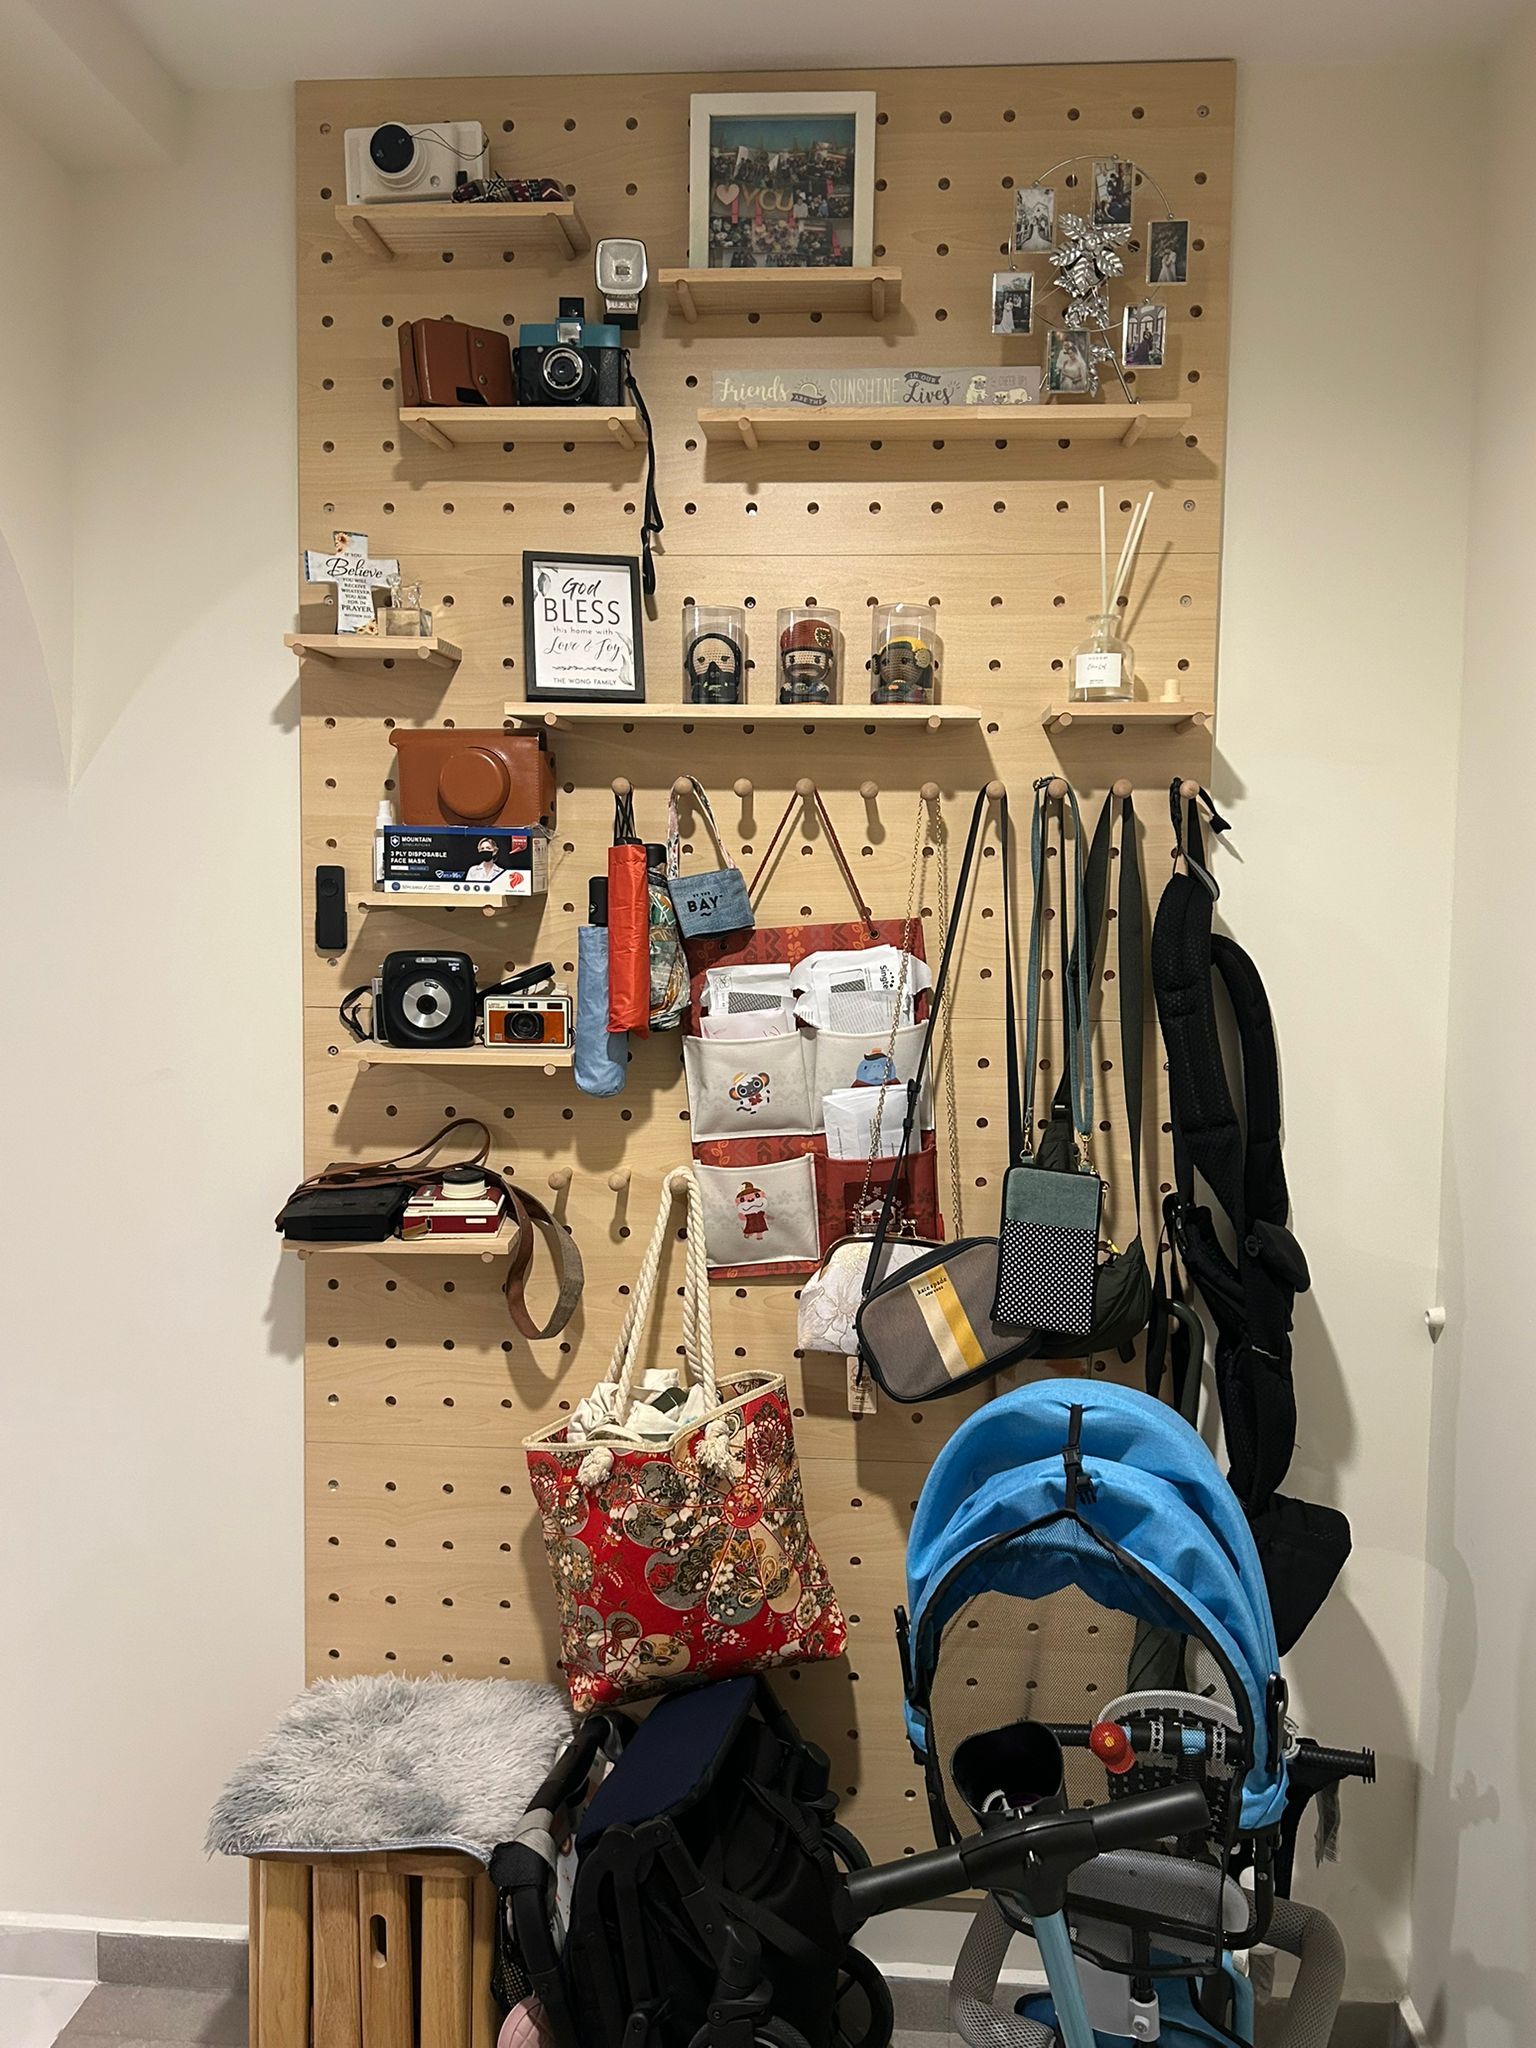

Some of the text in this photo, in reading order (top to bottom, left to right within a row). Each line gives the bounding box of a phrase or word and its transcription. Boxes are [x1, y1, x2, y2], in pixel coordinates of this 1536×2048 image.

[742, 184, 794, 212] YOU
[909, 371, 937, 384] IN OUR
[716, 376, 791, 402] Friends
[794, 394, 807, 402] ARE
[830, 378, 900, 405] SUNSHINE
[902, 381, 955, 405] Lives
[326, 558, 383, 578] Believe
[562, 577, 602, 600] God
[341, 604, 373, 613] PRAYER
[544, 598, 620, 625] BLESS
[596, 627, 614, 635] with
[544, 636, 620, 662] Love & Joy
[686, 896, 719, 912] BAY
[880, 965, 890, 990] Singte
[917, 1278, 947, 1294] kate spade
